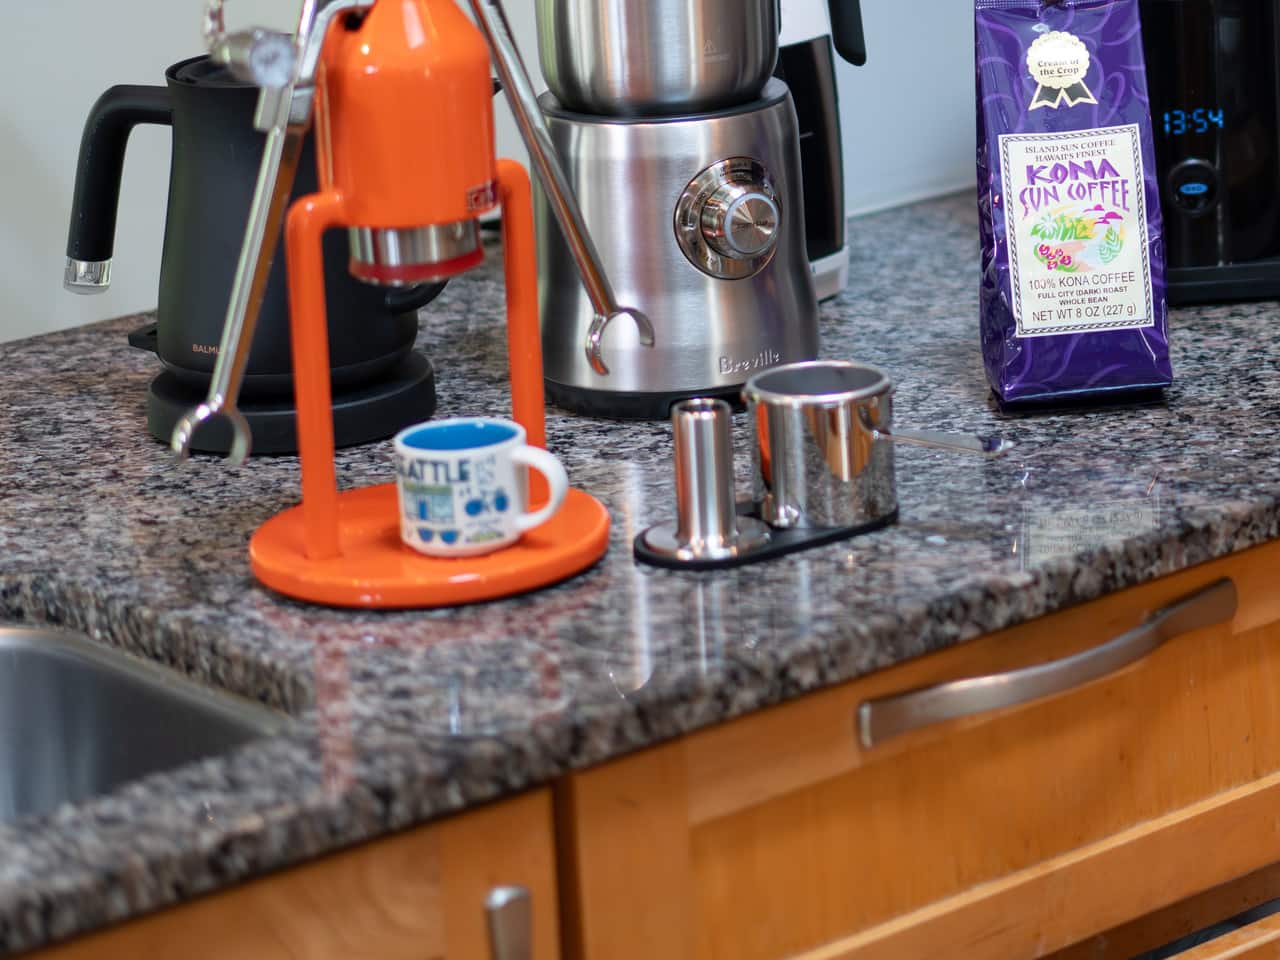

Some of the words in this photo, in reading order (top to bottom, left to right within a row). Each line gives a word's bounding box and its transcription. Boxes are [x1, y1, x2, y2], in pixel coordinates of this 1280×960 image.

[1040, 68, 1055, 76] the
[1163, 107, 1224, 135] 13:54
[1025, 145, 1059, 154] ISLAND
[1060, 143, 1080, 151] SUN
[1080, 139, 1117, 149] COFFEE
[1076, 148, 1106, 159] FINEST
[1026, 158, 1120, 186] KONA
[1019, 185, 1060, 218] SUN
[1067, 179, 1130, 212] COFFEE
[1029, 279, 1056, 290] 100%
[1059, 276, 1089, 288] KONA
[1091, 271, 1135, 285] COFFEE
[1058, 290, 1074, 298] CITY
[1076, 288, 1101, 296] (DARK)
[1103, 286, 1128, 294] ROAST
[1059, 298, 1086, 306] WHOLE
[1087, 296, 1108, 304] BEAN
[1032, 310, 1053, 321] NET
[1056, 308, 1073, 320] WT
[1076, 308, 1082, 318] 8
[1085, 306, 1100, 317] OZ
[1102, 304, 1123, 317] (227
[1127, 303, 1137, 316] g)
[720, 349, 780, 374] Breville
[398, 457, 471, 482] ATTLE
